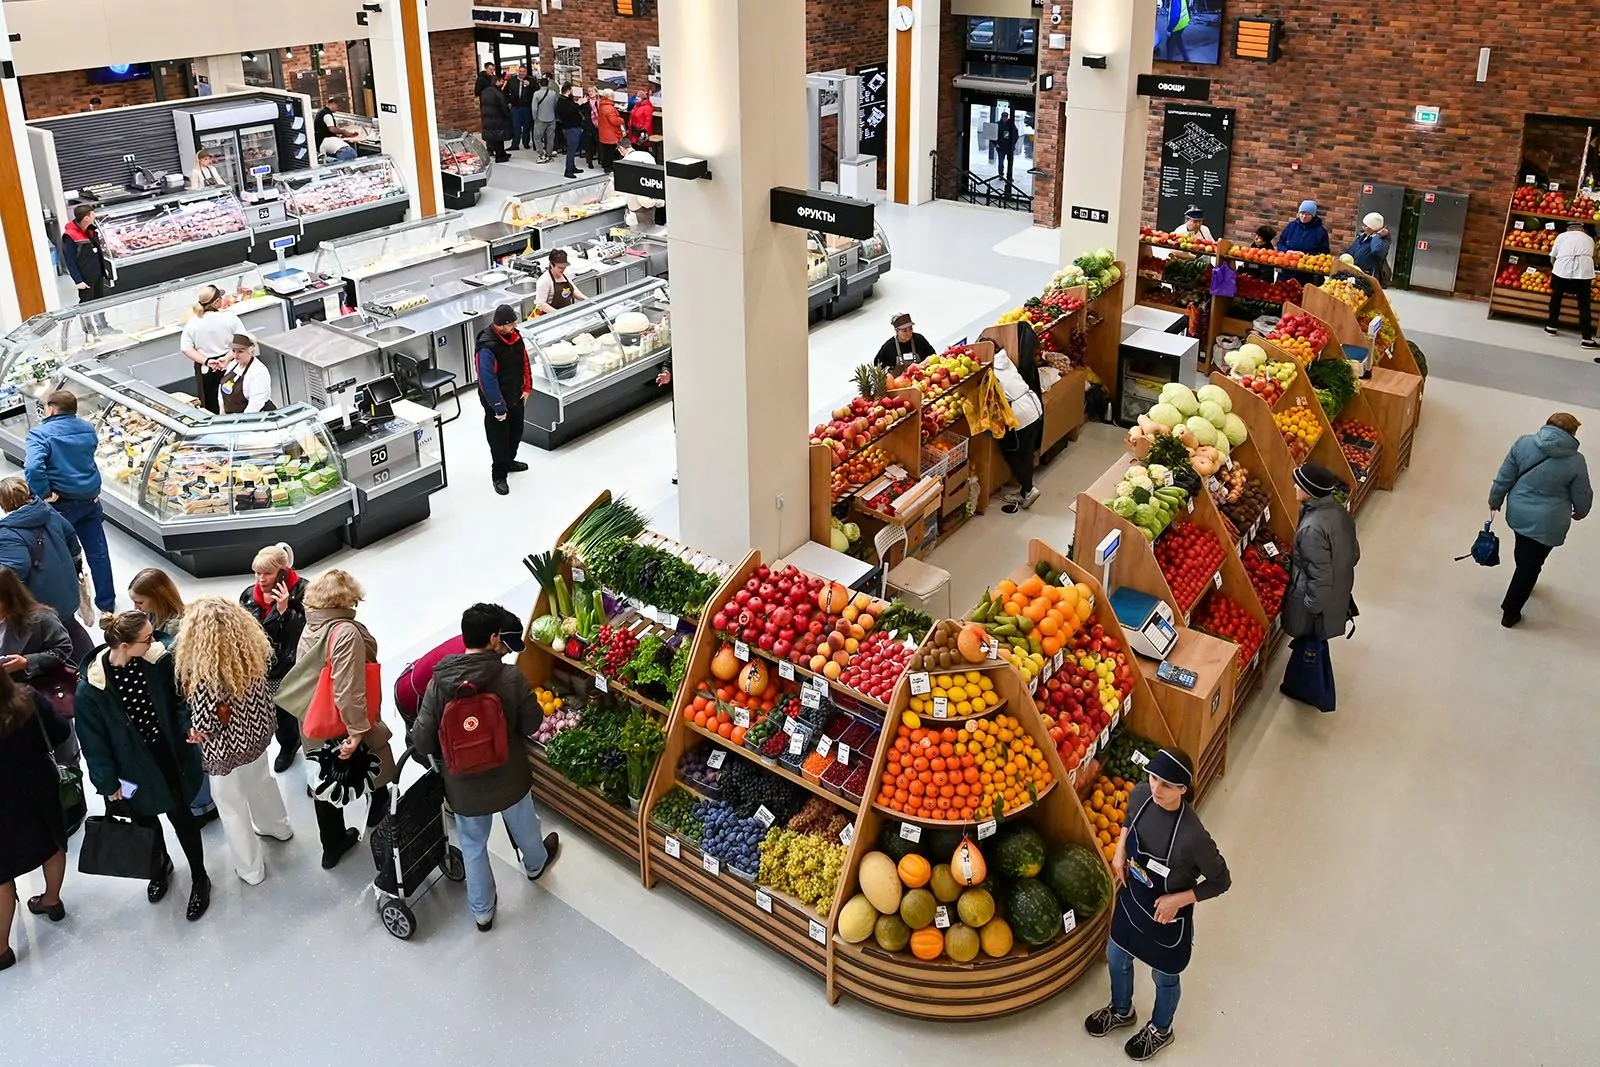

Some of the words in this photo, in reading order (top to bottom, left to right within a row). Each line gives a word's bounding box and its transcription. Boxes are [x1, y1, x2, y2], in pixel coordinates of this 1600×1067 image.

[1158, 82, 1185, 92] ОВОЩИ
[640, 177, 663, 189] СЫРЫ
[260, 210, 269, 218] 26
[797, 206, 836, 223] ФРУКТЫ
[372, 450, 386, 464] 20
